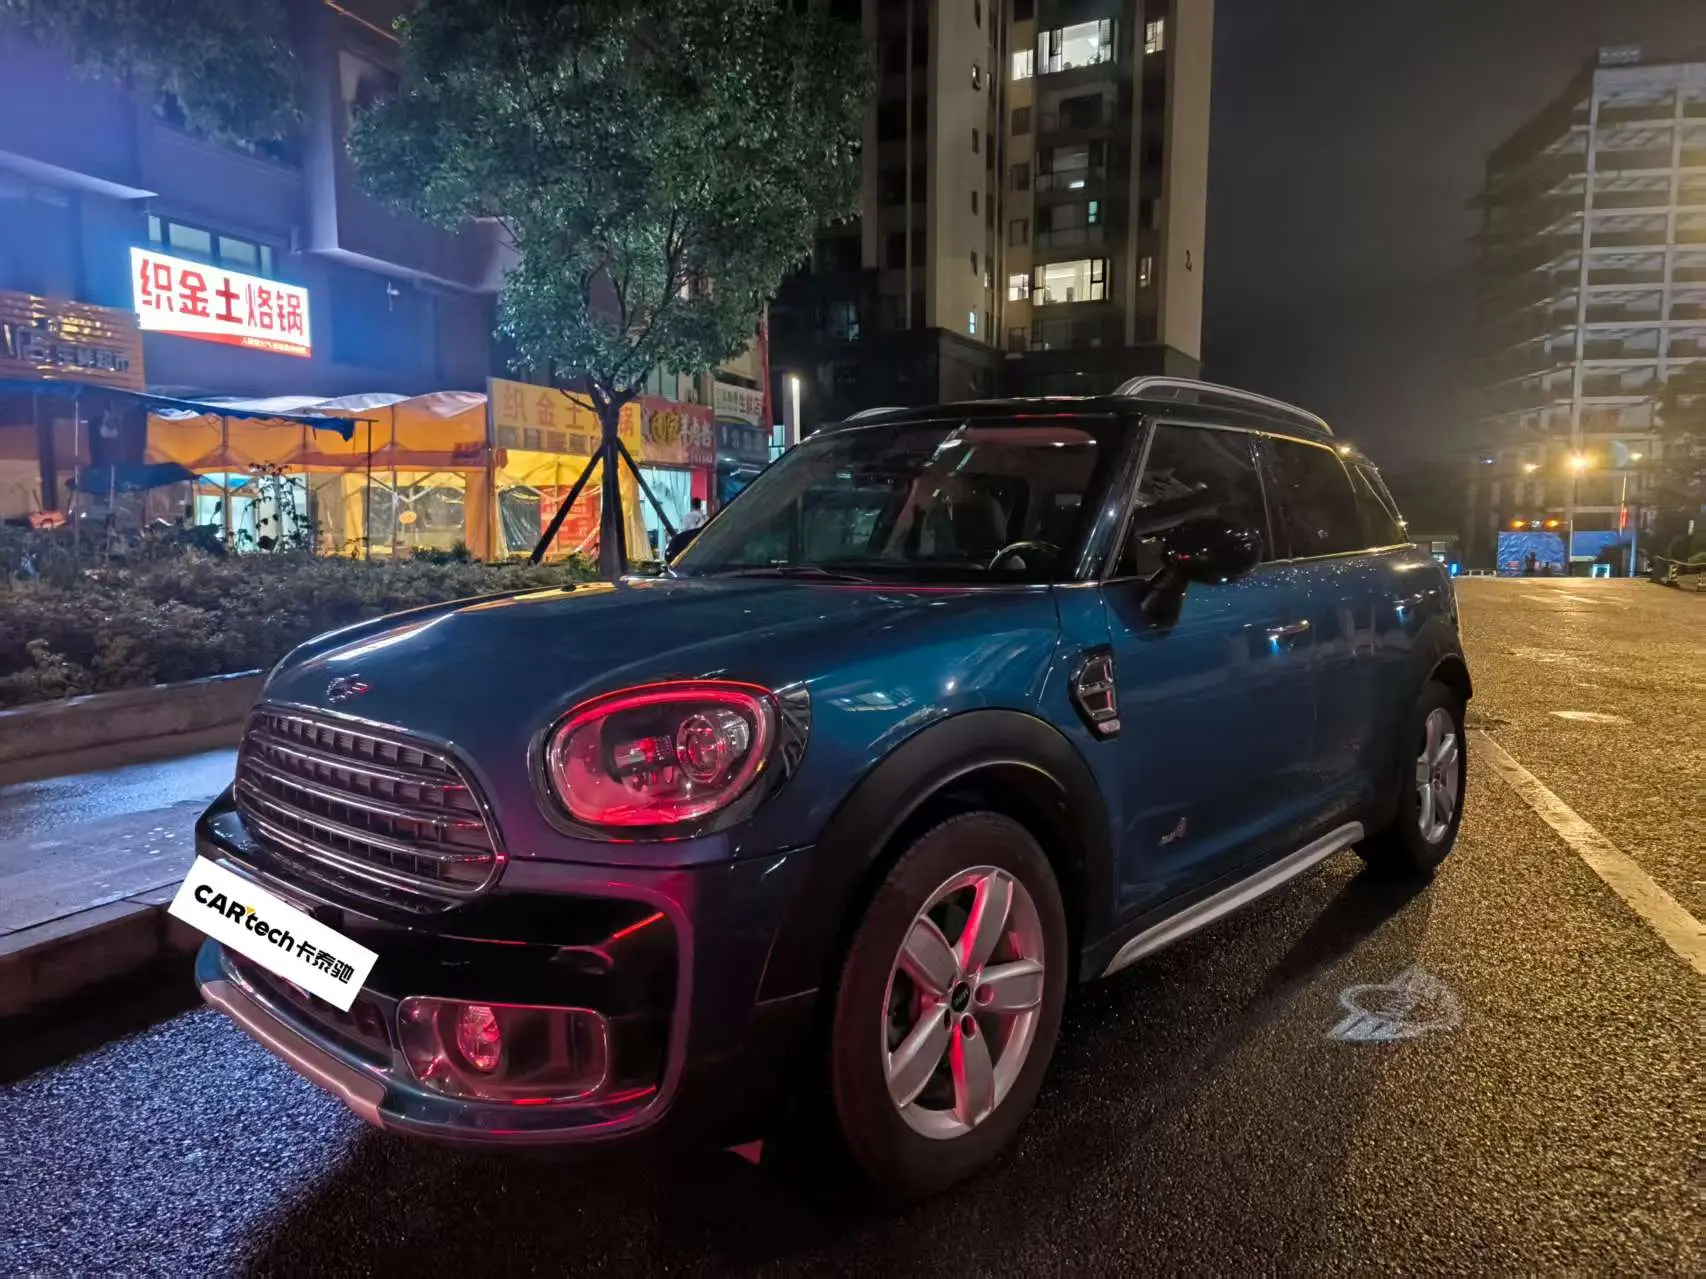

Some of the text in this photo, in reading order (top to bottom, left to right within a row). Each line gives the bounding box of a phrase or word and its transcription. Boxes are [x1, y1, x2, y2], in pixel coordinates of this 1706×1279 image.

[140, 259, 303, 336] 织金土烙锅
[503, 383, 635, 438] 织金土锅
